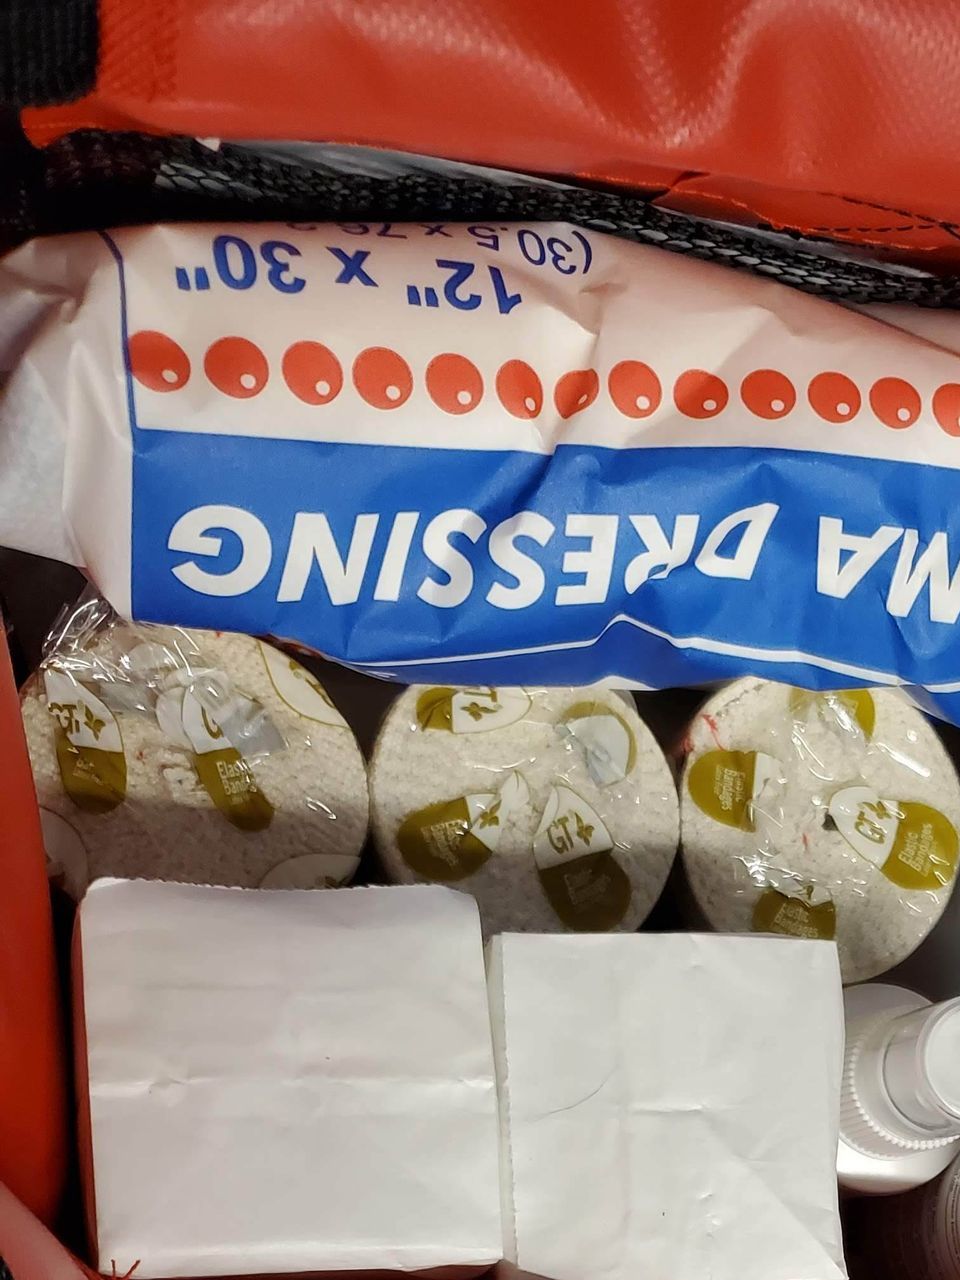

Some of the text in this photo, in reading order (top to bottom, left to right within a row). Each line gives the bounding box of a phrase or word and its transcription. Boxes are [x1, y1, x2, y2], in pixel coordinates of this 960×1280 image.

[175, 234, 522, 315] 12" x 30"
[166, 501, 780, 611] DRESSING
